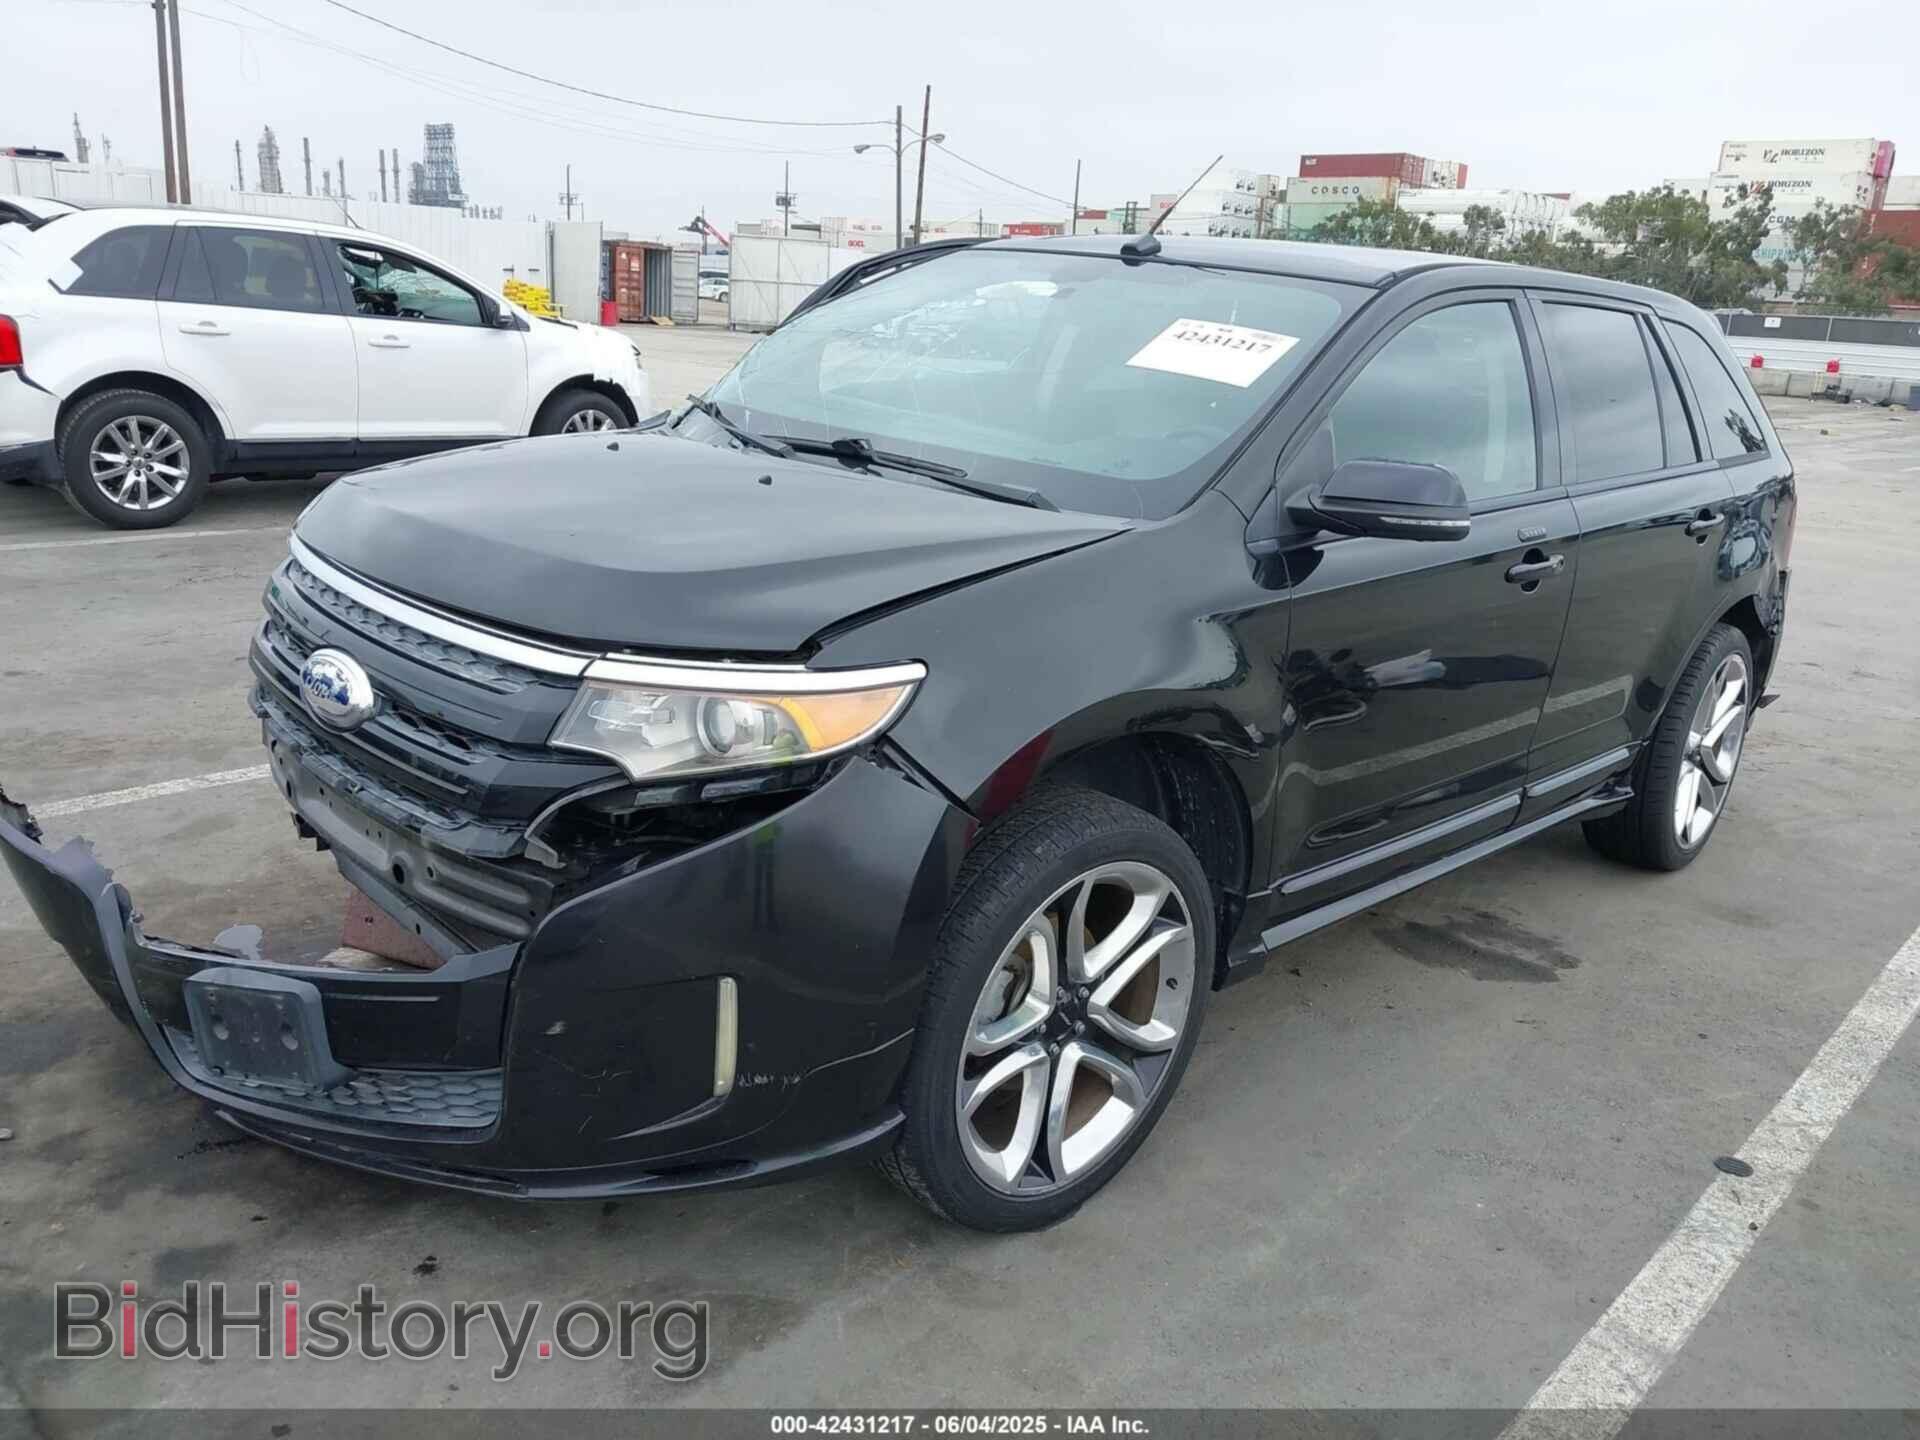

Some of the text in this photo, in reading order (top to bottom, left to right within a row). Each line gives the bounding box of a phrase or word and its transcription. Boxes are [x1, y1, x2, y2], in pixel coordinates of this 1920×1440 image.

[1780, 148, 1826, 156] HORIZON
[1311, 186, 1361, 194] COSCO
[1173, 330, 1273, 353] 42431217
